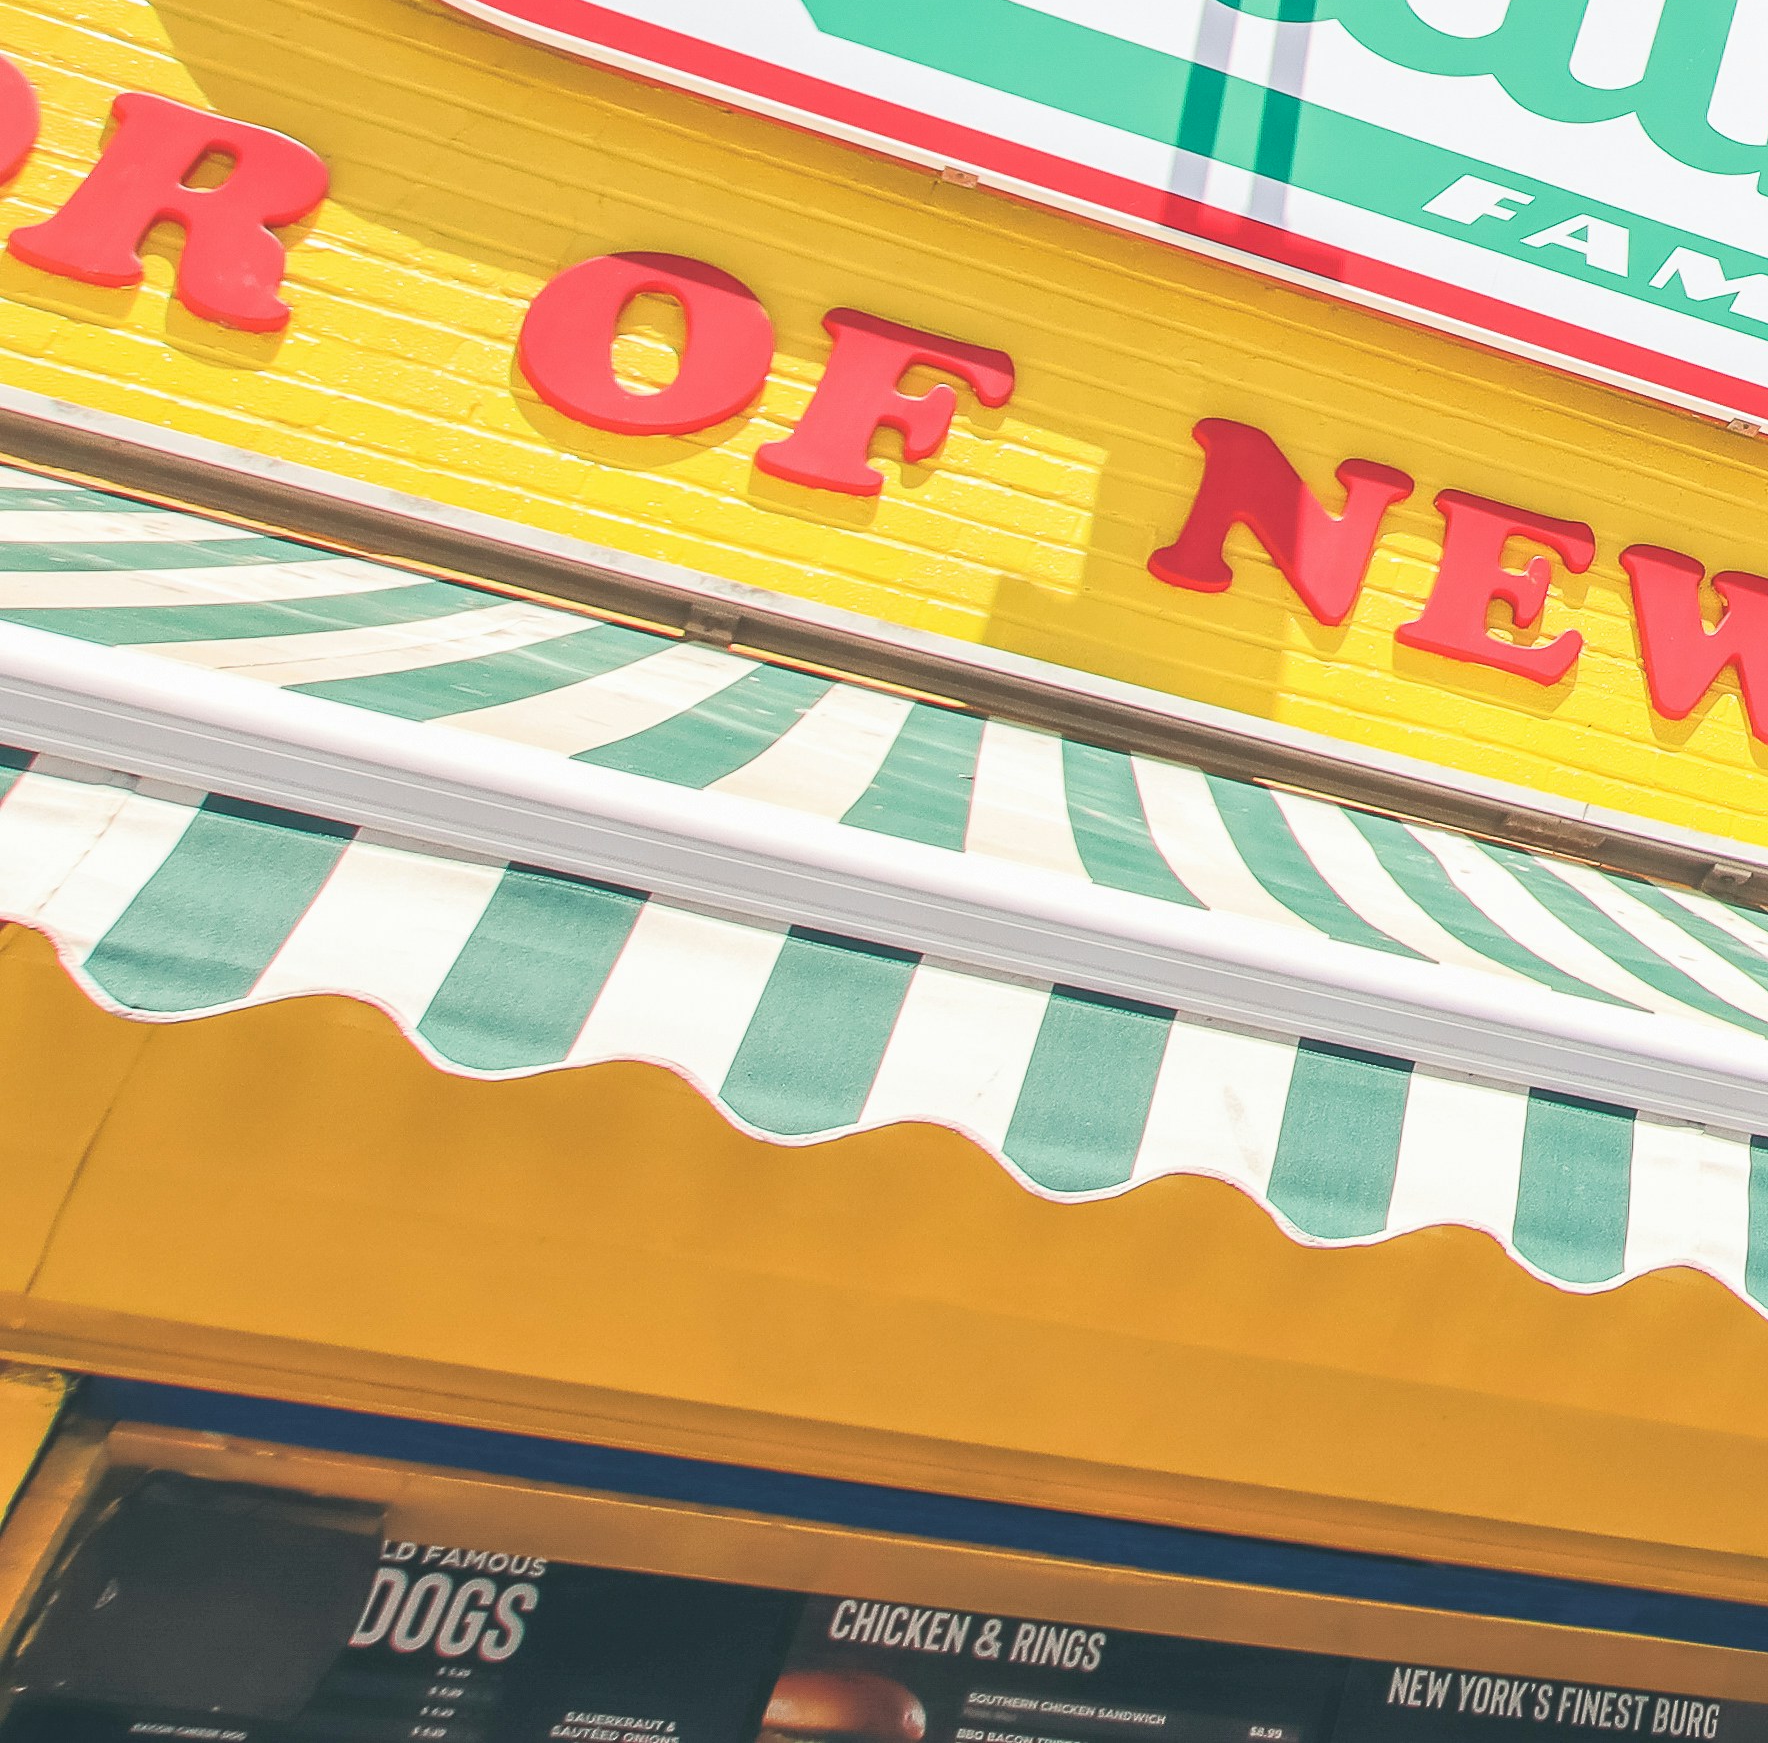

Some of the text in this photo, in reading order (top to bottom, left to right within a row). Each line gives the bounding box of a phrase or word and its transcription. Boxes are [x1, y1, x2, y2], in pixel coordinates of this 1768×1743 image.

[0, 65, 330, 332] R
[517, 250, 1015, 497] OF
[421, 1544, 548, 1578] FAMOUS
[349, 1566, 541, 1663] DOGS
[828, 1599, 1108, 1672] CHICKEN & RINGS
[564, 1710, 664, 1731] SAUERKRAUT
[967, 1691, 1039, 1710] SOUTHERN
[1039, 1700, 1097, 1717] CHICKEN
[1097, 1708, 1167, 1726] SANDWICH
[1386, 1666, 1452, 1709] NEW
[1457, 1673, 1553, 1722] YORK'S
[1555, 1685, 1650, 1732] FINEST
